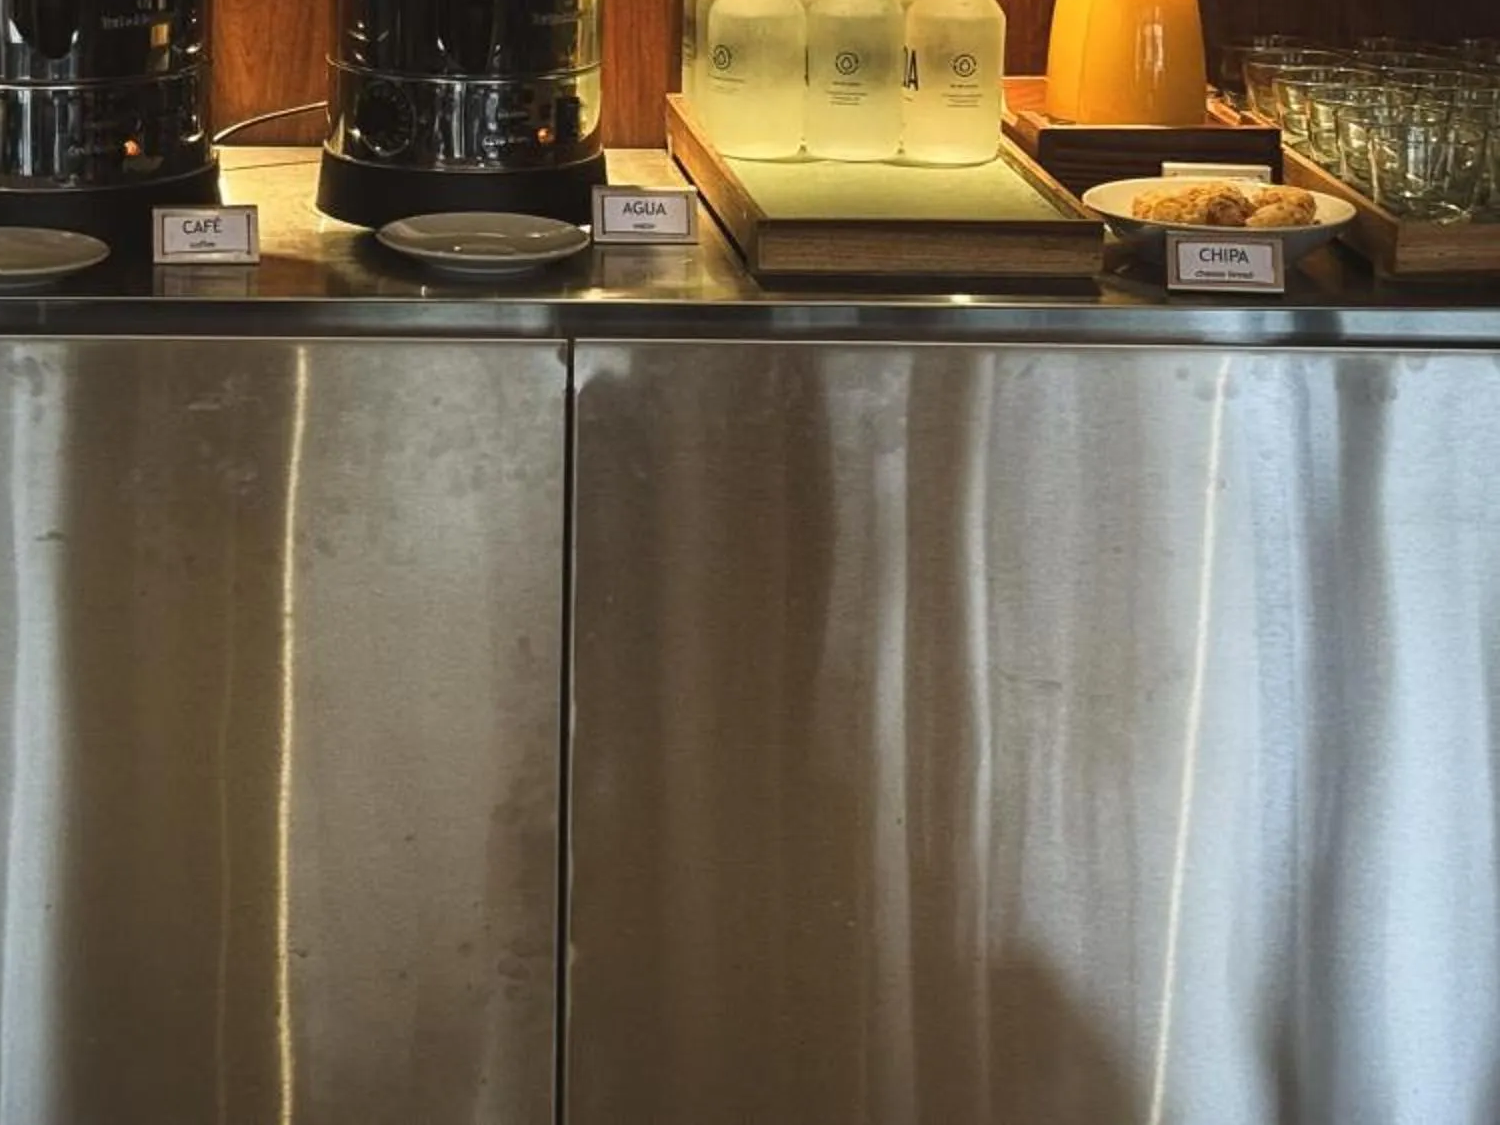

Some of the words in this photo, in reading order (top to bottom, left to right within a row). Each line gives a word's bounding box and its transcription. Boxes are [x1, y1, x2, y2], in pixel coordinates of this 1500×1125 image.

[622, 201, 667, 215] AGUA
[182, 216, 222, 234] CAFÉ
[1199, 248, 1249, 263] CHIPA
